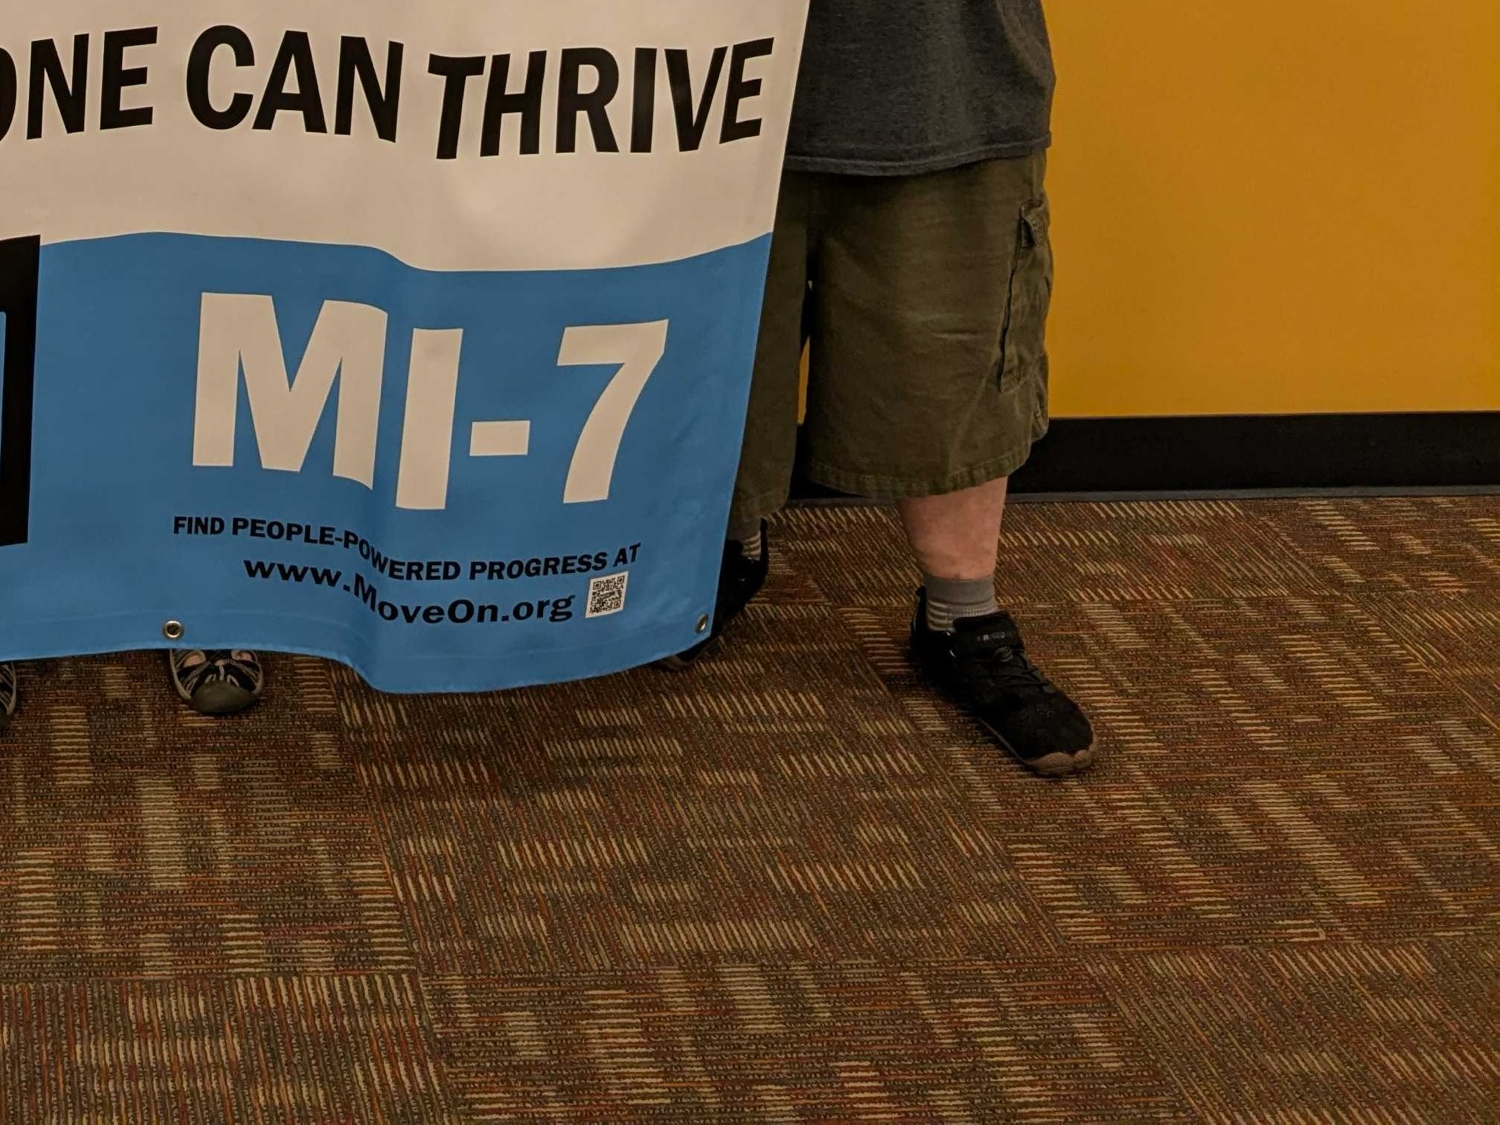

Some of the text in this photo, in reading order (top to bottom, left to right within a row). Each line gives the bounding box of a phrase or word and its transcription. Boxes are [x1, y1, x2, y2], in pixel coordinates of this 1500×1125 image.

[186, 25, 404, 143] CAN
[427, 37, 775, 159] THRIVE
[192, 292, 669, 510] MI-7
[173, 515, 642, 581] FIND PEOPLE-POWERED PROGRESS AT
[244, 559, 576, 624] www.MoveOn.org
